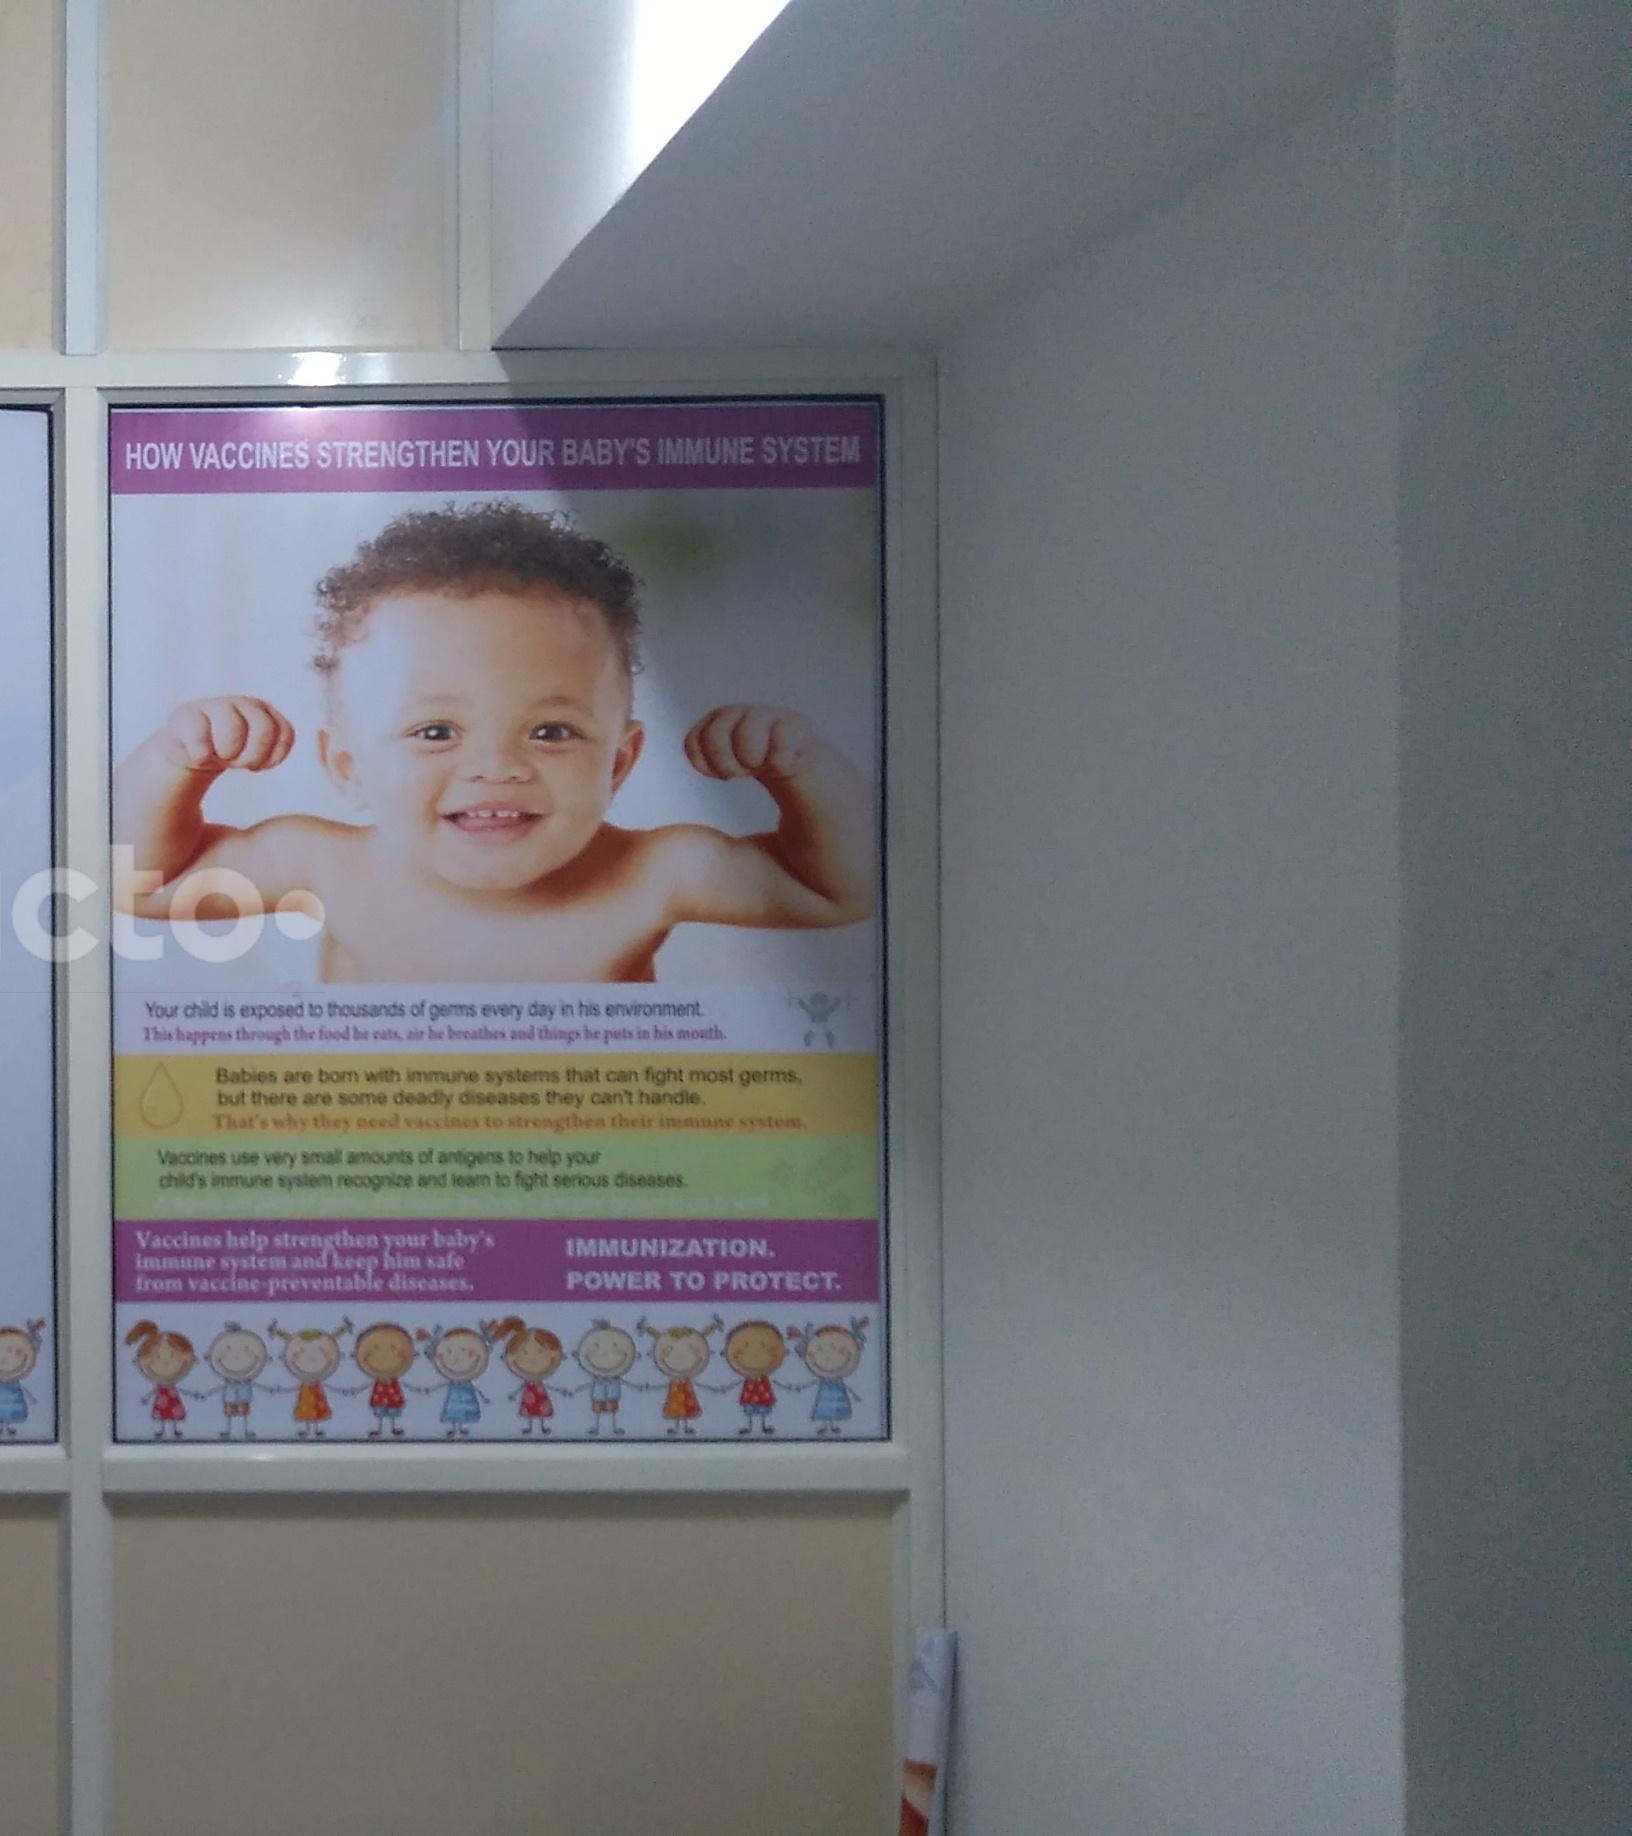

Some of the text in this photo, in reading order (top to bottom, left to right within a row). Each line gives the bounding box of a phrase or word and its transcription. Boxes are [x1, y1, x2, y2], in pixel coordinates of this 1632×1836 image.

[125, 435, 861, 470] HOW VACCINES STRENGTHEN YOUR BABY'S IMMUNE SYSTEM
[146, 1000, 705, 1023] Your child is exposed to thousands of germs every day in his environment.
[216, 1067, 804, 1086] Babies are born with immune systems that can fight most germs,
[218, 1090, 707, 1110] but there are some deadly diseases they can't handle.
[158, 1147, 603, 1169] Vaccines use very small amounts of antigens to help your
[159, 1170, 690, 1193] child's immune system recognize and learn to fight serious diseases.
[136, 1229, 496, 1256] Vaccines help strengthen your baby's
[566, 1238, 777, 1259] IMMUNIZATION.
[136, 1253, 465, 1276] immune system and keep him safe
[137, 1273, 476, 1295] from vaccine-preventable diseases.
[567, 1271, 843, 1293] POWER TO PROTECT.
